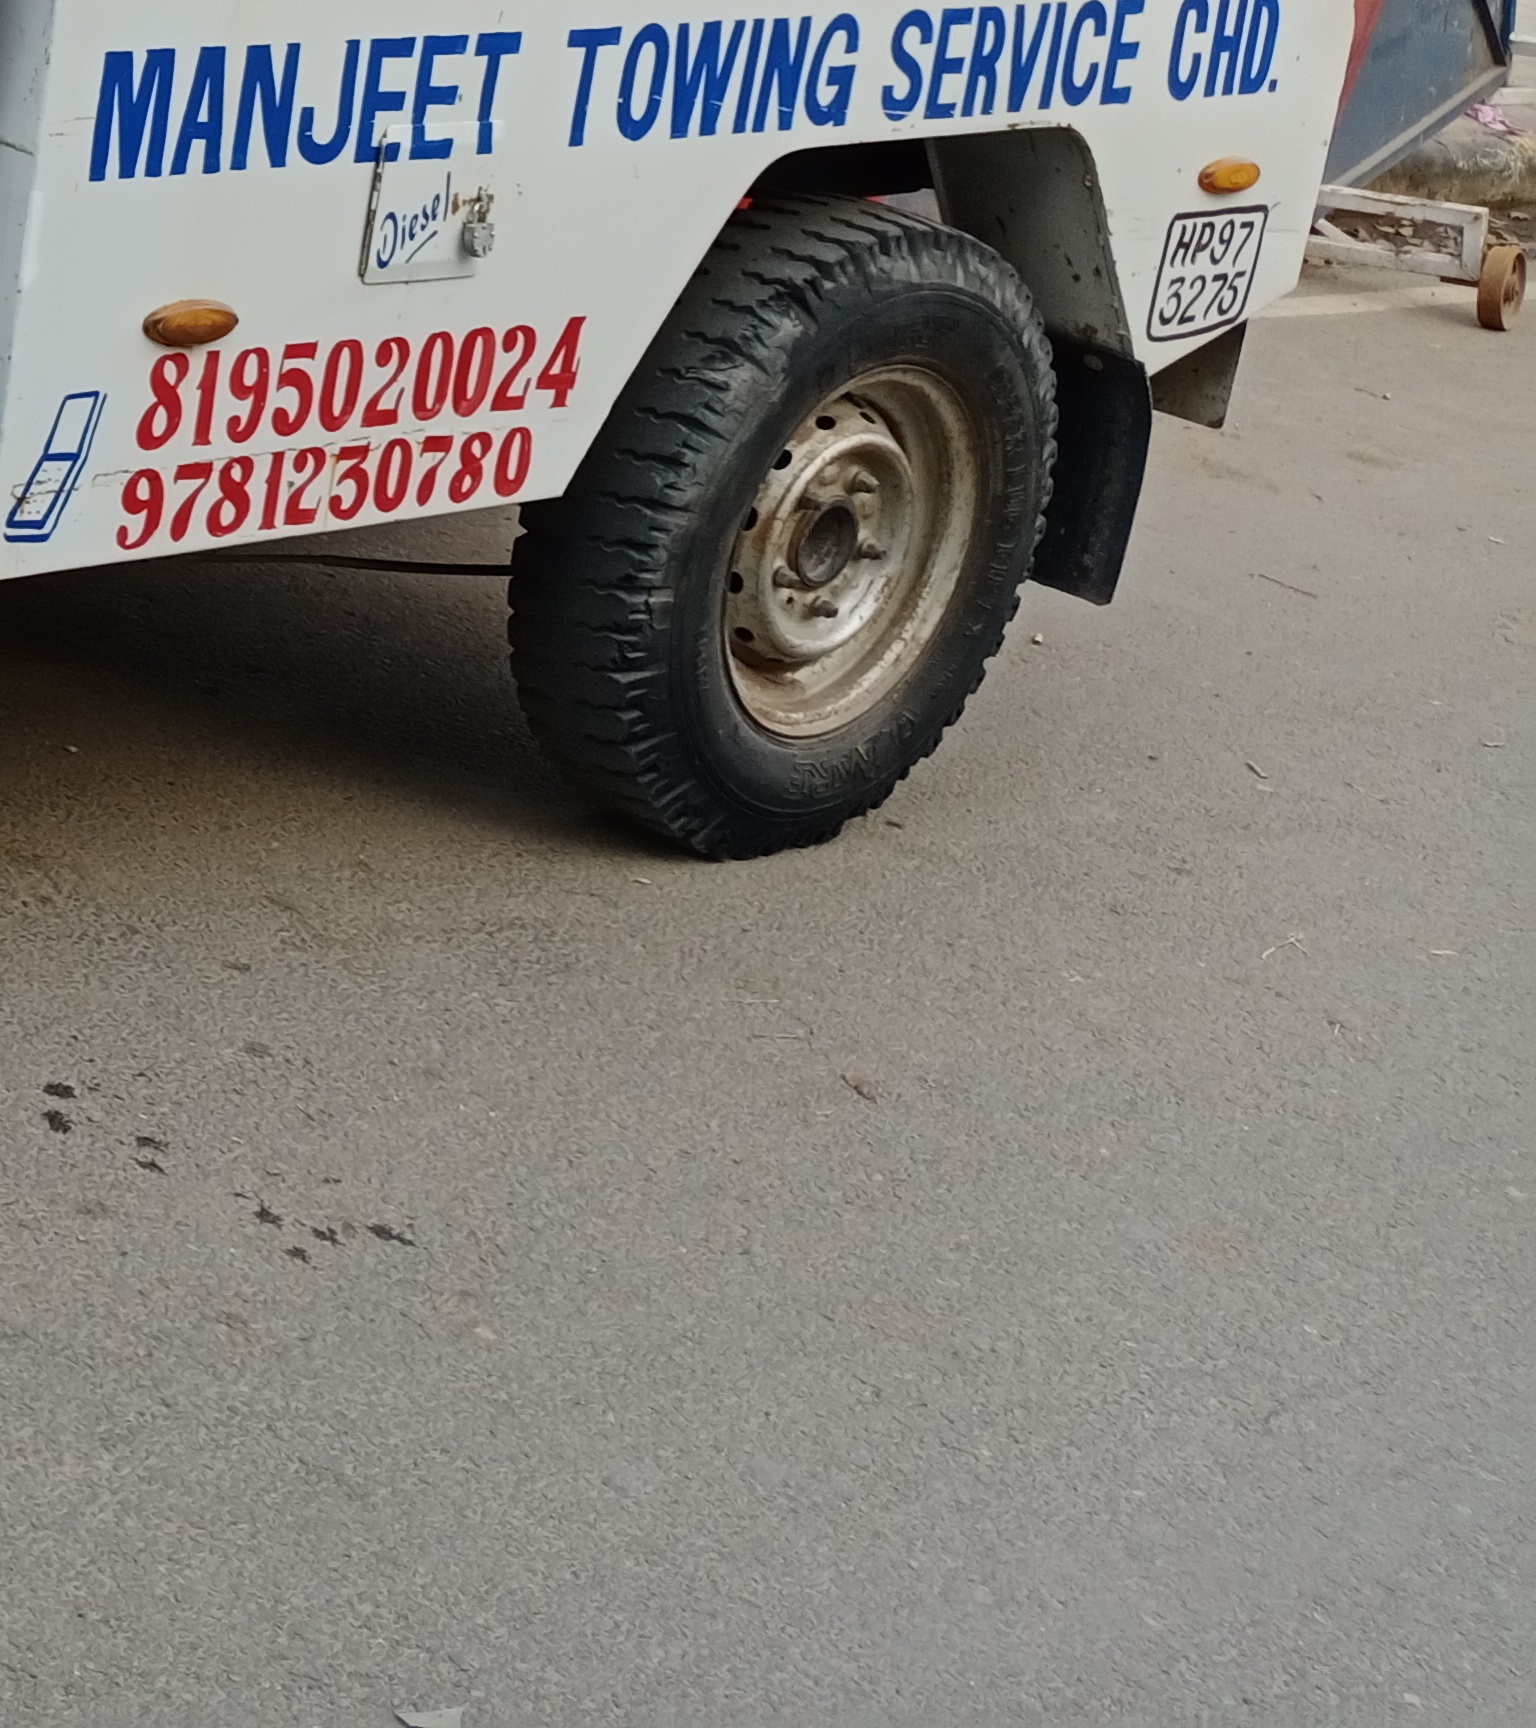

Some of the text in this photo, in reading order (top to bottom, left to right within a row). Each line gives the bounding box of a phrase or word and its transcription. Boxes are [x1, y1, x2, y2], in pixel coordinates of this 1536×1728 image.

[88, 31, 523, 182] MANJEET
[567, 12, 860, 148] TOWING
[375, 171, 453, 270] Diesel
[1168, 218, 1255, 269] HP97
[1158, 270, 1248, 326] 3275
[135, 315, 588, 452] 8195020024
[115, 425, 533, 551] 9781230780
